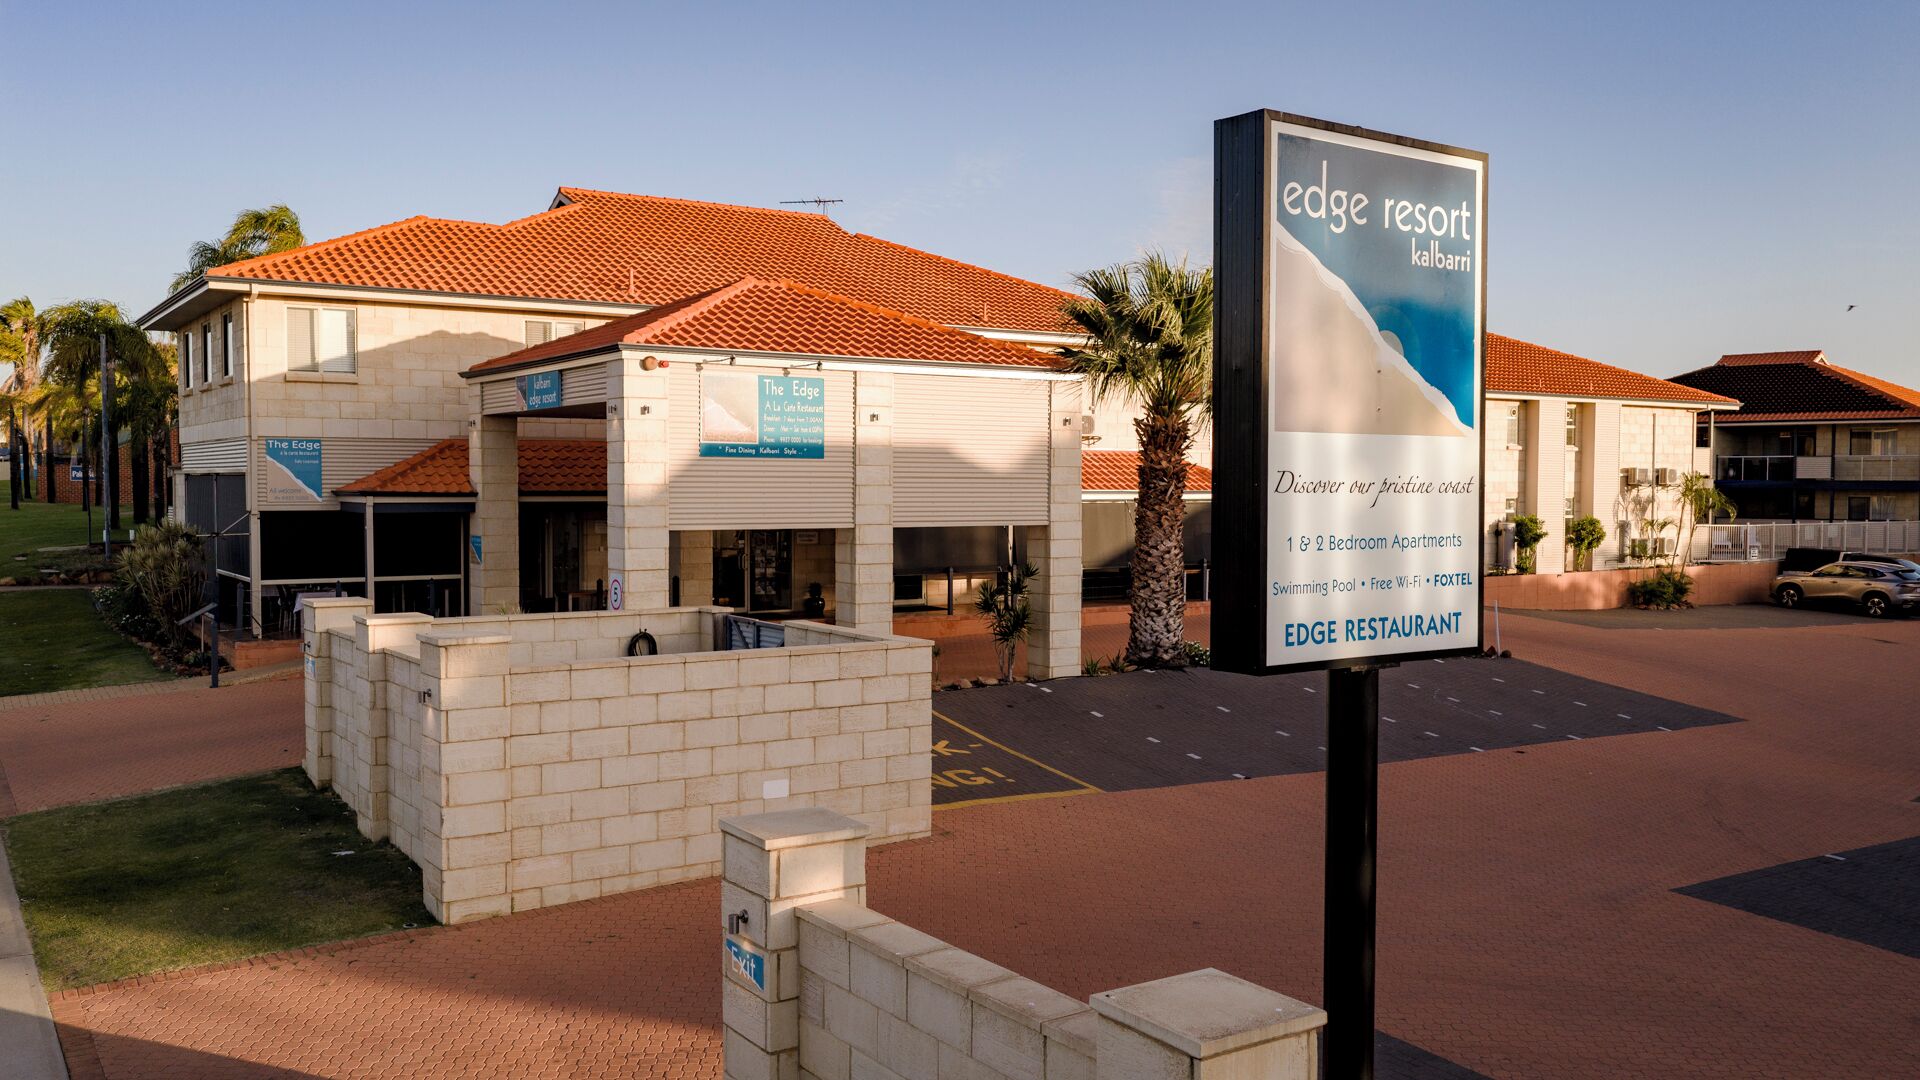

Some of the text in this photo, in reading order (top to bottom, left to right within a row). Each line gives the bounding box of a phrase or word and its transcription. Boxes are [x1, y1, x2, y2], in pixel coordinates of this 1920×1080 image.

[1283, 160, 1471, 241] edge resort
[1411, 237, 1471, 272] kalbarri
[529, 390, 557, 408] edge resort
[763, 379, 820, 400] The Edge
[765, 401, 772, 411] A
[773, 401, 781, 412] La
[797, 401, 823, 413] Restaurant
[268, 439, 321, 451] The Edge
[725, 446, 737, 454] Fine
[738, 446, 756, 455] Dining
[783, 447, 797, 456] Style
[1274, 470, 1475, 509] Discover our pristine coast
[1287, 533, 1462, 552] 1 & 2 Bedroom Apartments
[613, 586, 619, 602] 5
[1272, 572, 1473, 597] Swimming Pool Free Wi-Fi FOXTEL
[1285, 611, 1462, 648] EDGE RESTAURANT
[731, 946, 756, 980] Exit
